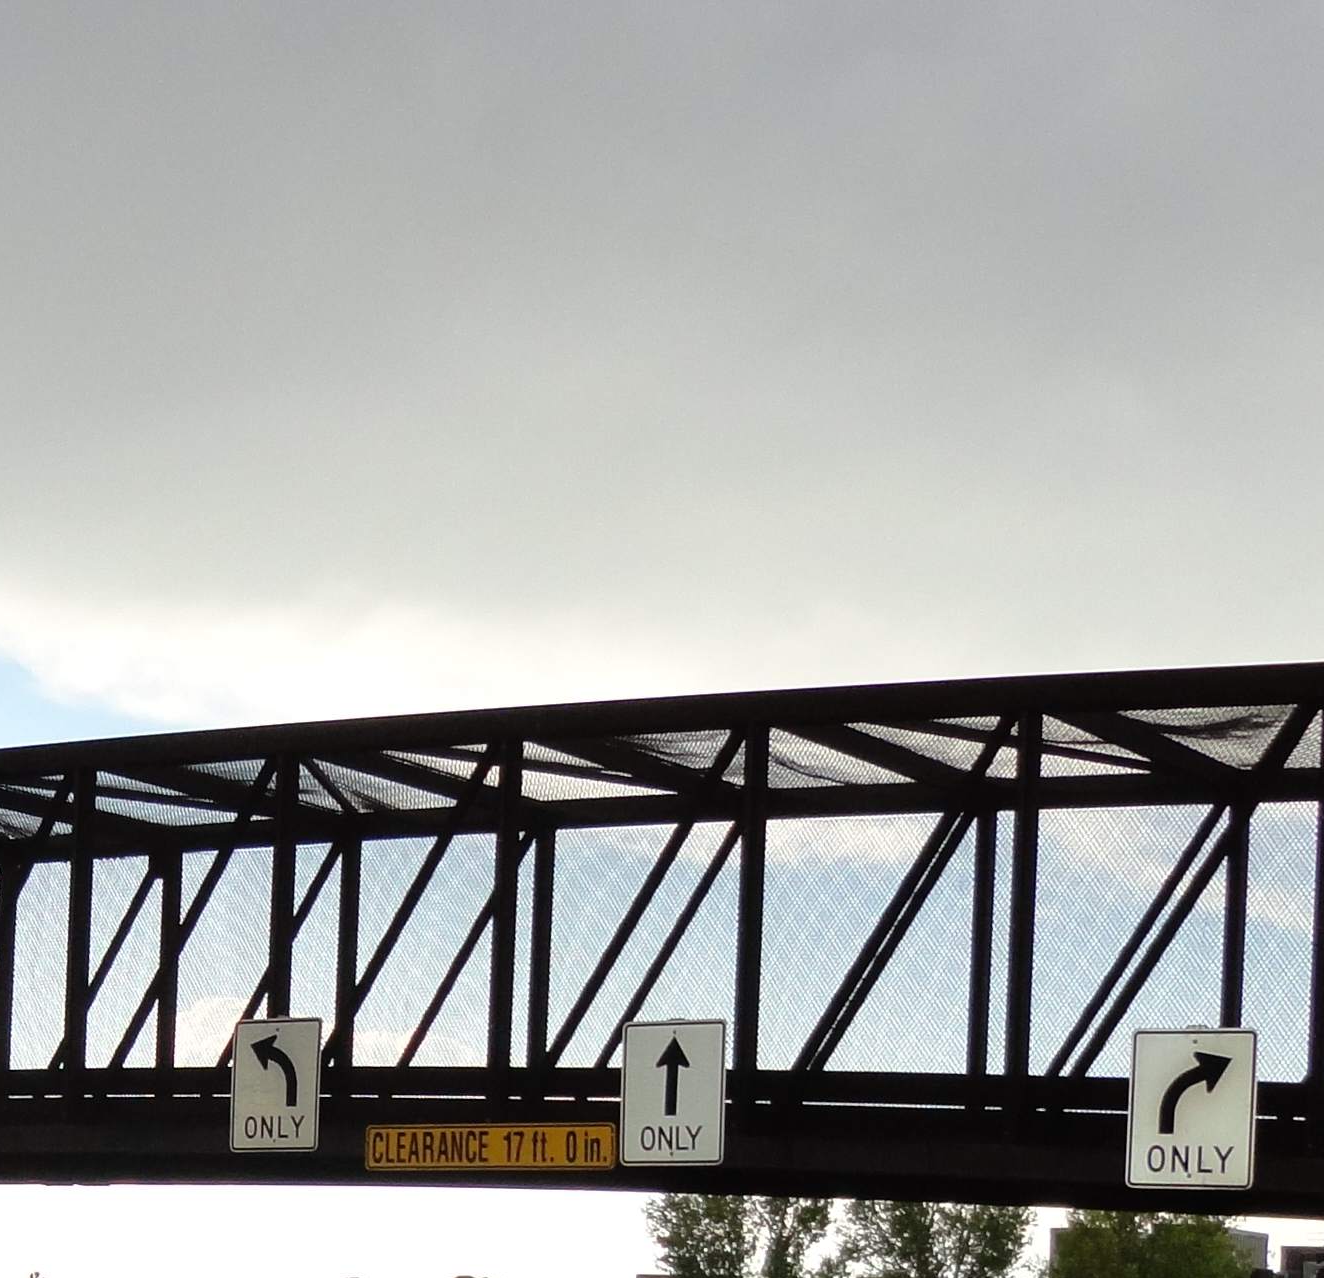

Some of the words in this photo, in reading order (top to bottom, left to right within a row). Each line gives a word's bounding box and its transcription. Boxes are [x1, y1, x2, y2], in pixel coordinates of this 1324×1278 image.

[244, 1115, 305, 1139] ONLY
[640, 1125, 703, 1151] ONLY
[372, 1130, 490, 1164] CLEARANCE
[503, 1130, 525, 1163] 17
[531, 1130, 555, 1163] ft.
[565, 1130, 577, 1163] 0
[583, 1131, 608, 1163] in.
[1147, 1145, 1235, 1174] ONLY
